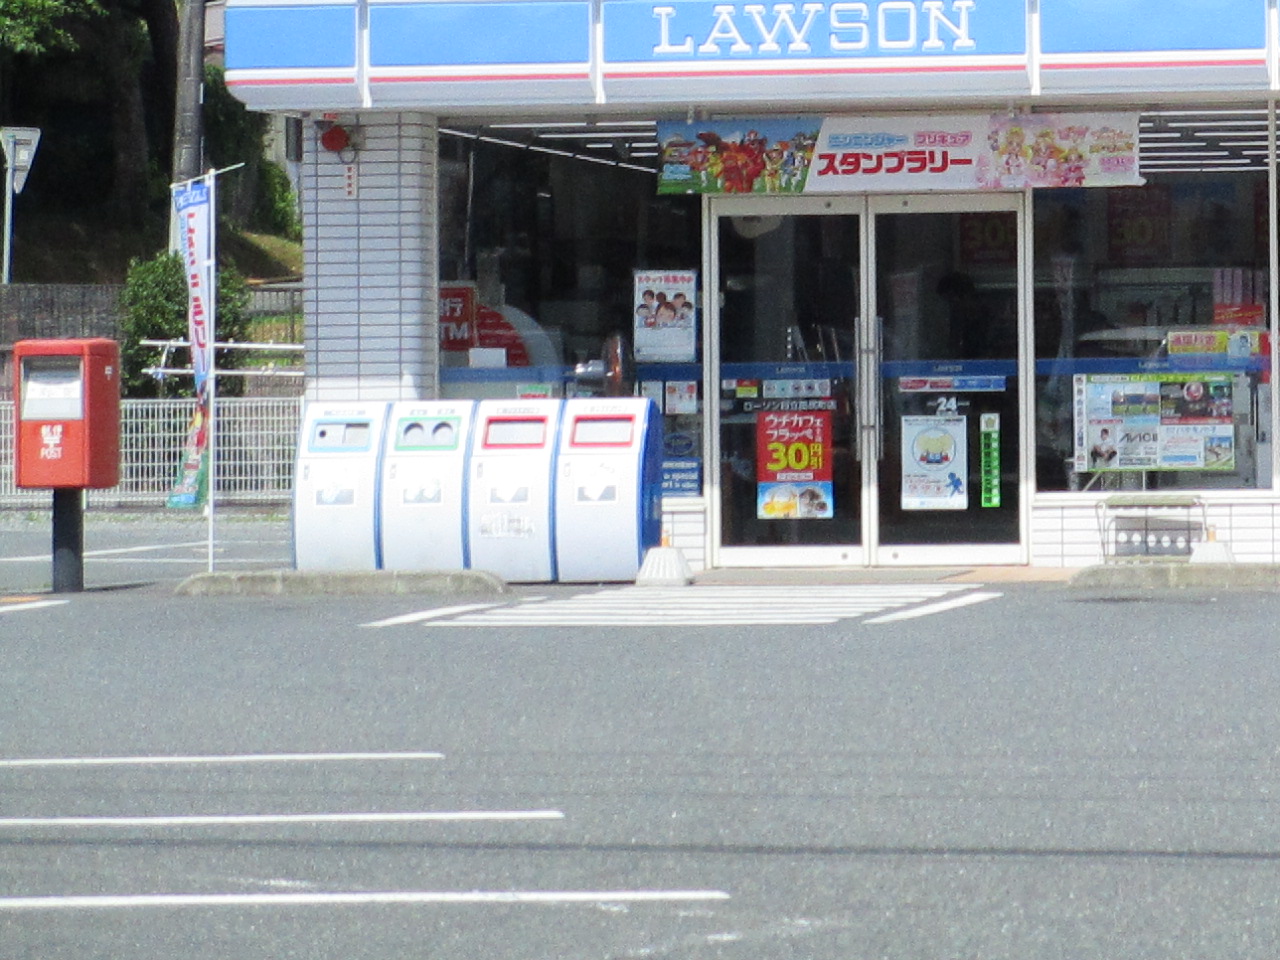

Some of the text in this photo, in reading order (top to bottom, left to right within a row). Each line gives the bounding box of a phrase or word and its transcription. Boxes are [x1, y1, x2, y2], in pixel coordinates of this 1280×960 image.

[652, 0, 977, 54] LAWSON
[915, 131, 972, 147] プリキュア
[817, 151, 972, 176] スタンプラリー
[766, 414, 823, 428] ウチカフェ
[766, 428, 813, 441] フラッペ
[40, 447, 62, 459] POST
